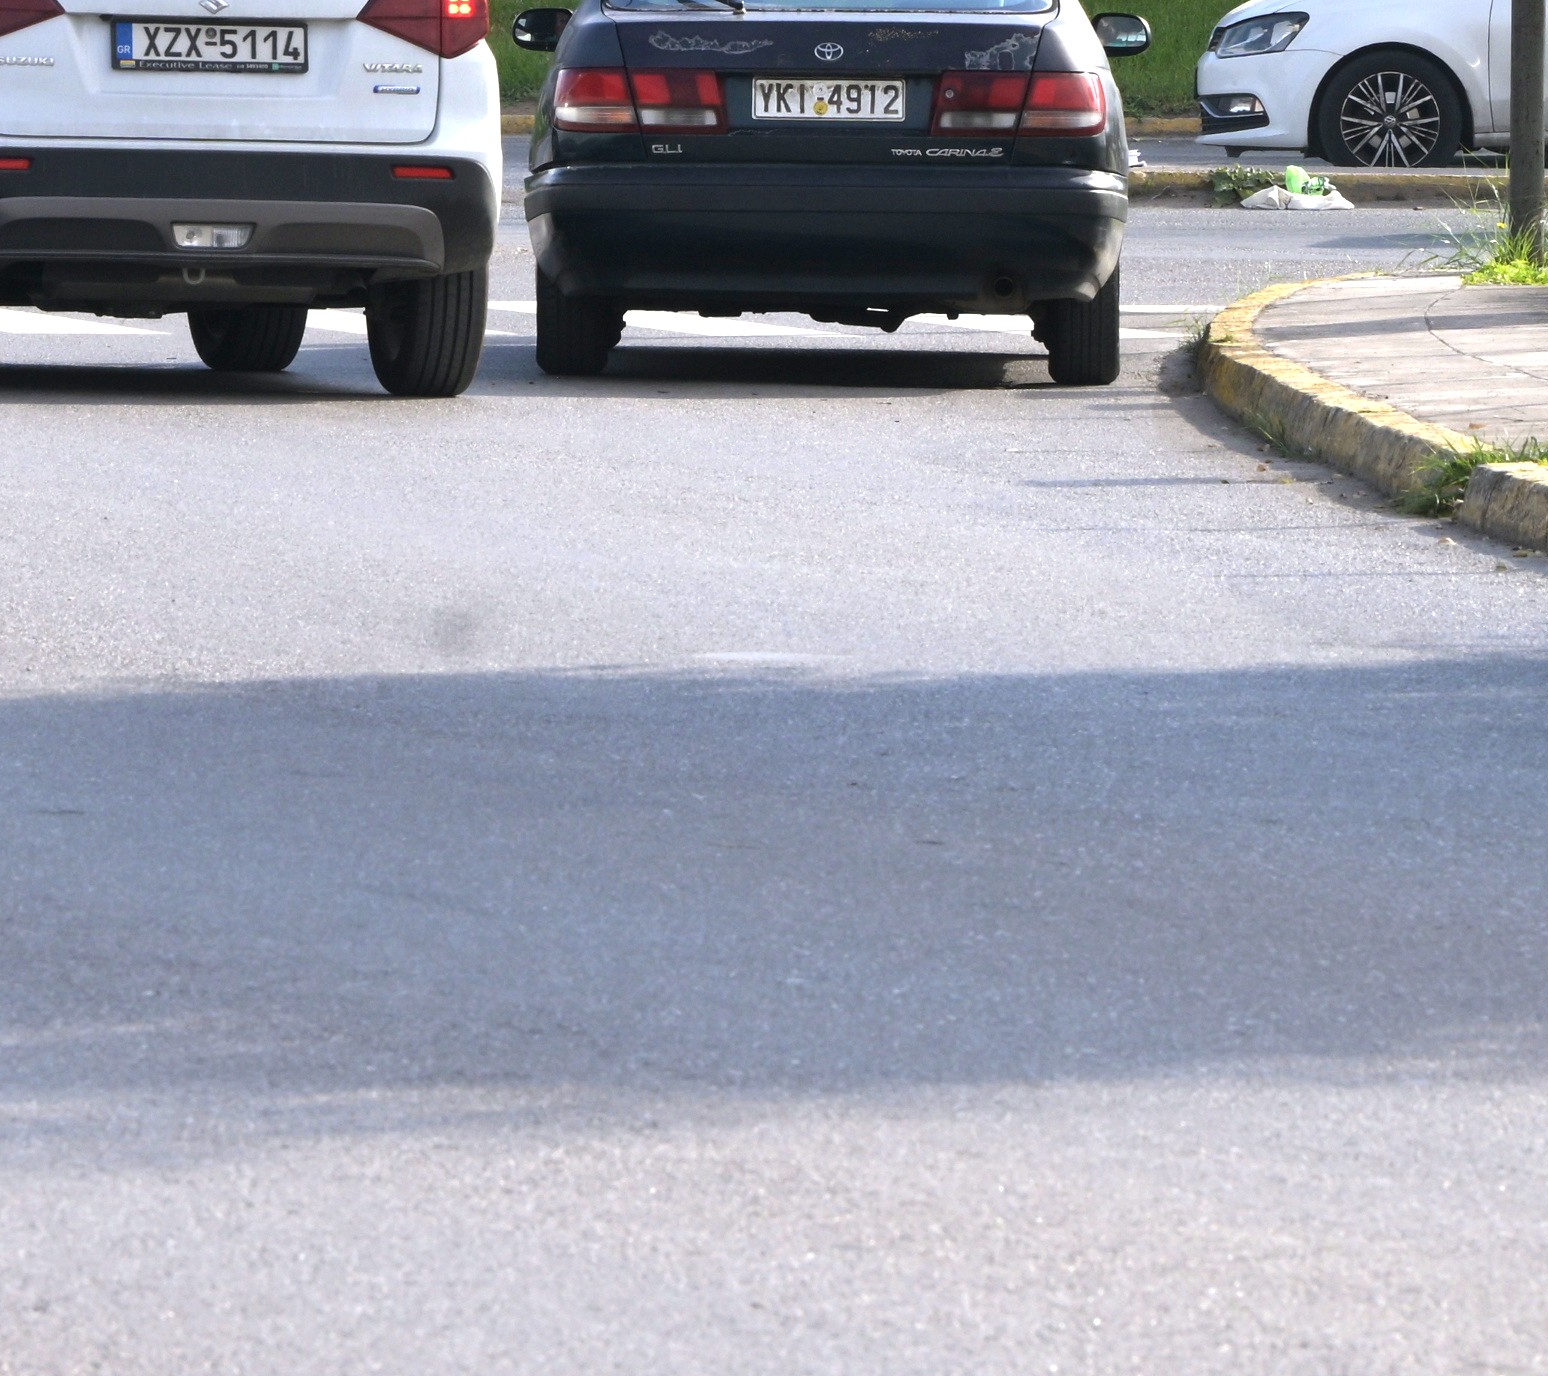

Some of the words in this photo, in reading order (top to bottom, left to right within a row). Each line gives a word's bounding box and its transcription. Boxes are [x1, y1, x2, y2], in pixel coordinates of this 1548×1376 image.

[117, 45, 131, 54] GR
[139, 60, 195, 69] Executive
[199, 61, 233, 70] Lease
[363, 63, 423, 73] VITARA
